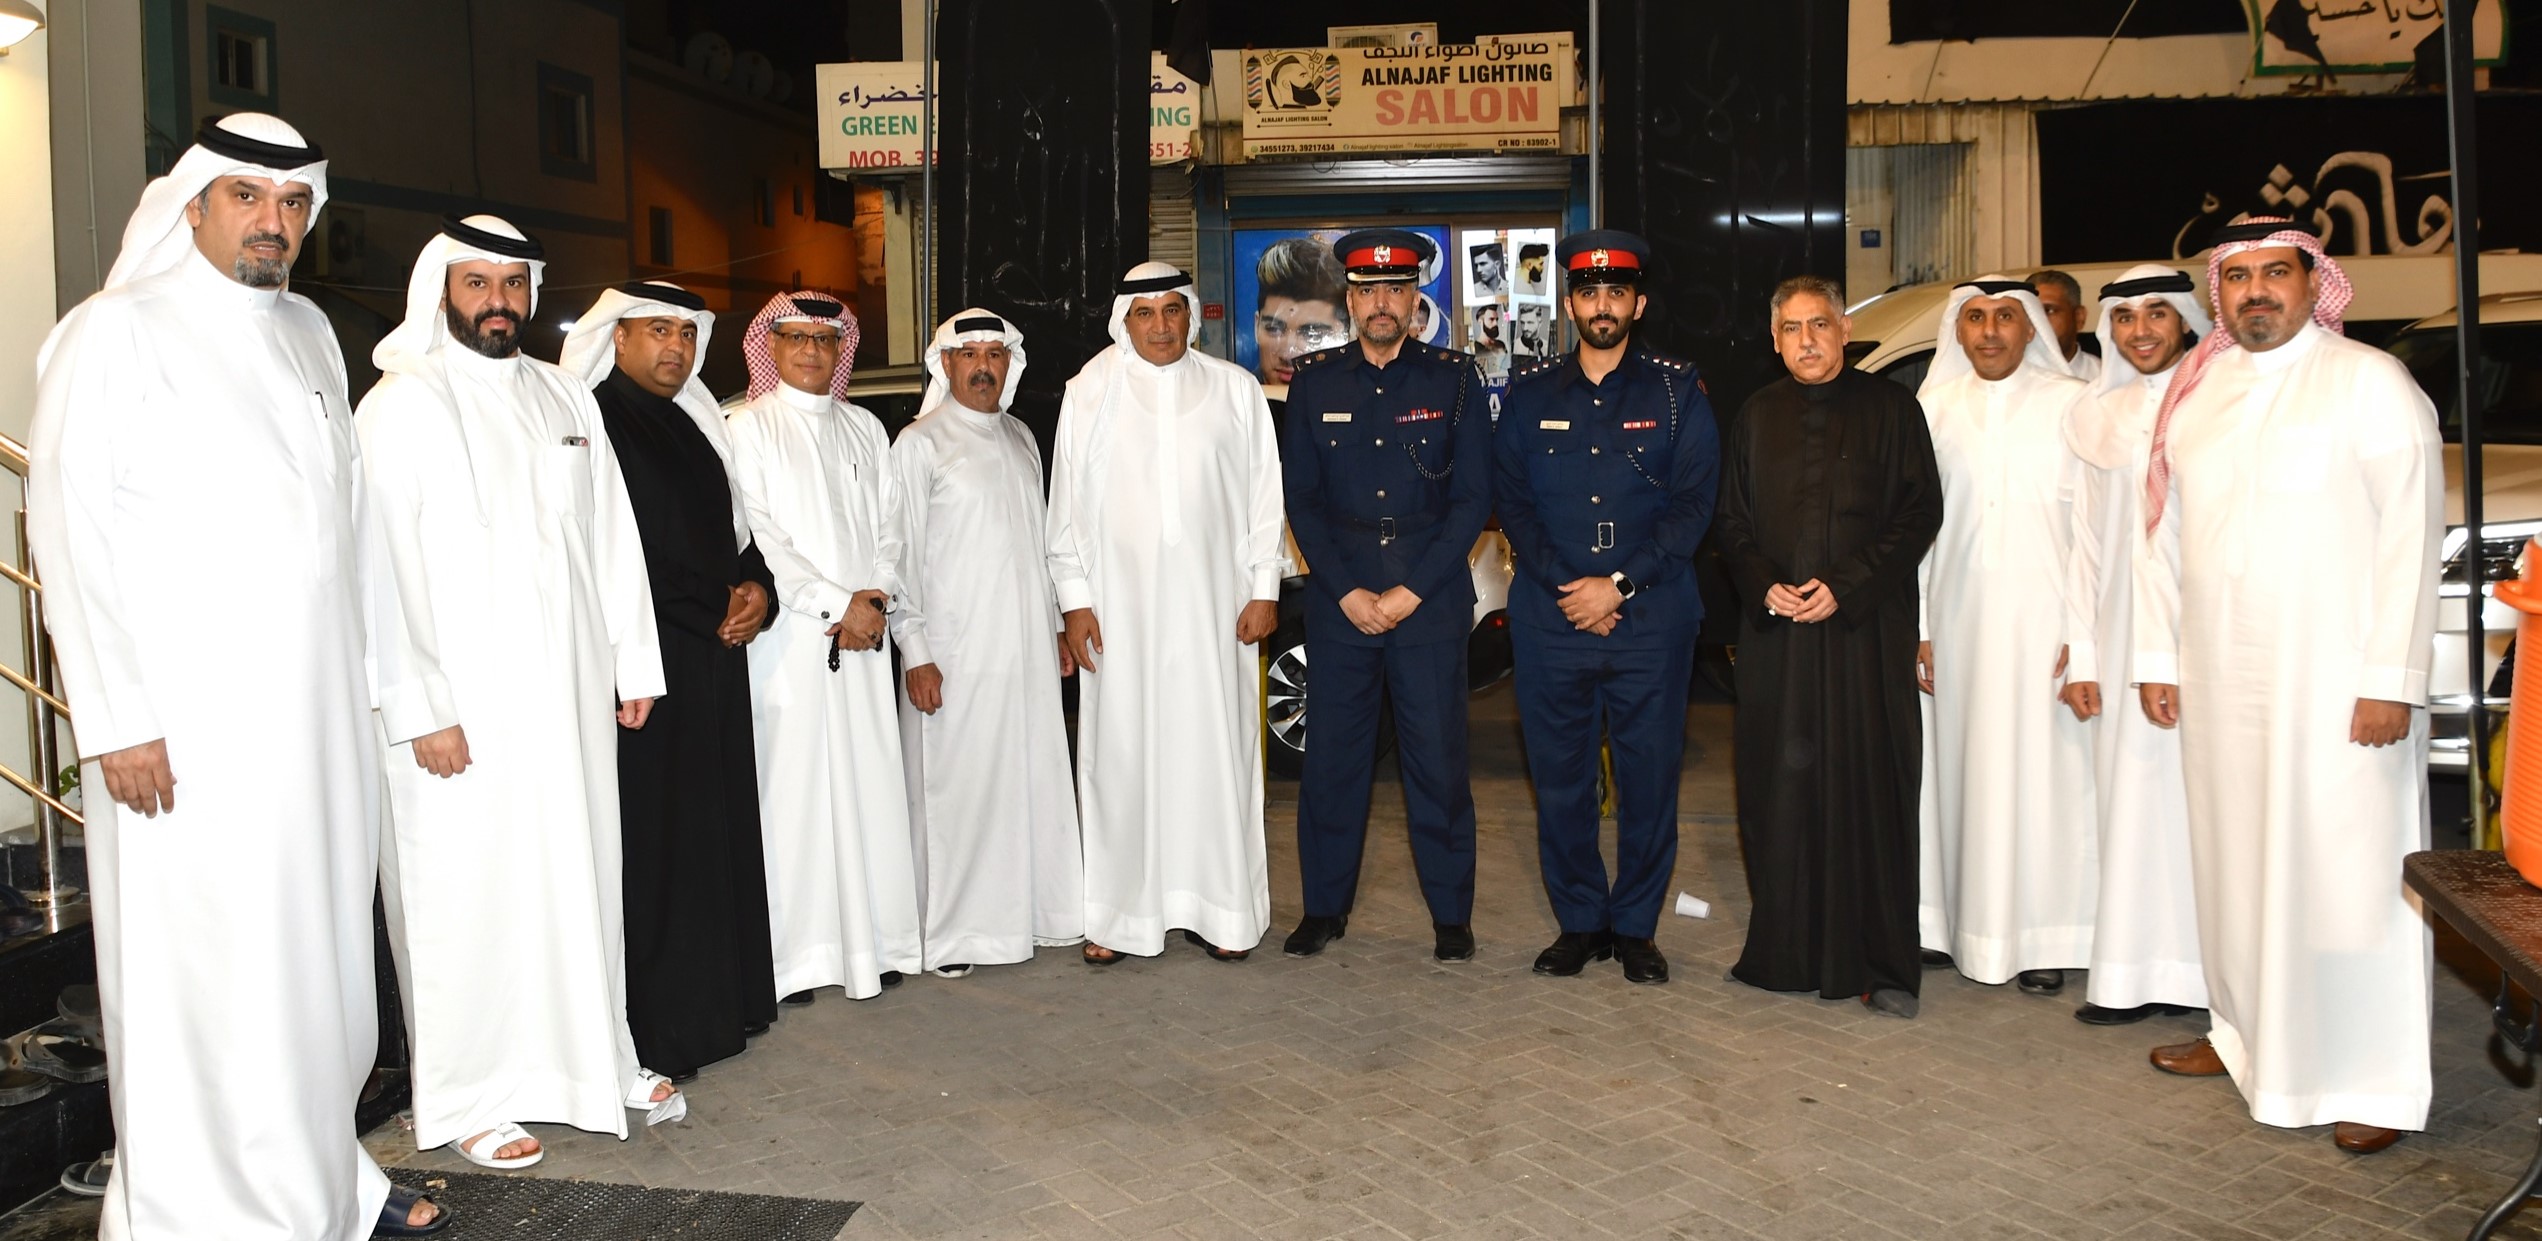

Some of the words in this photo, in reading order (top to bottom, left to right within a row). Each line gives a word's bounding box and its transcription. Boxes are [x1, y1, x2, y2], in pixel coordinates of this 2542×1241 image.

[1361, 66, 1451, 86] ALNAJAF
[1458, 63, 1552, 84] LIGHTING
[1375, 86, 1539, 126] SALON
[841, 115, 917, 136] GREEN
[1299, 143, 1335, 152] 39217434
[1498, 139, 1508, 147] CR
[1510, 139, 1520, 147] NO
[850, 150, 907, 167] MOB.
